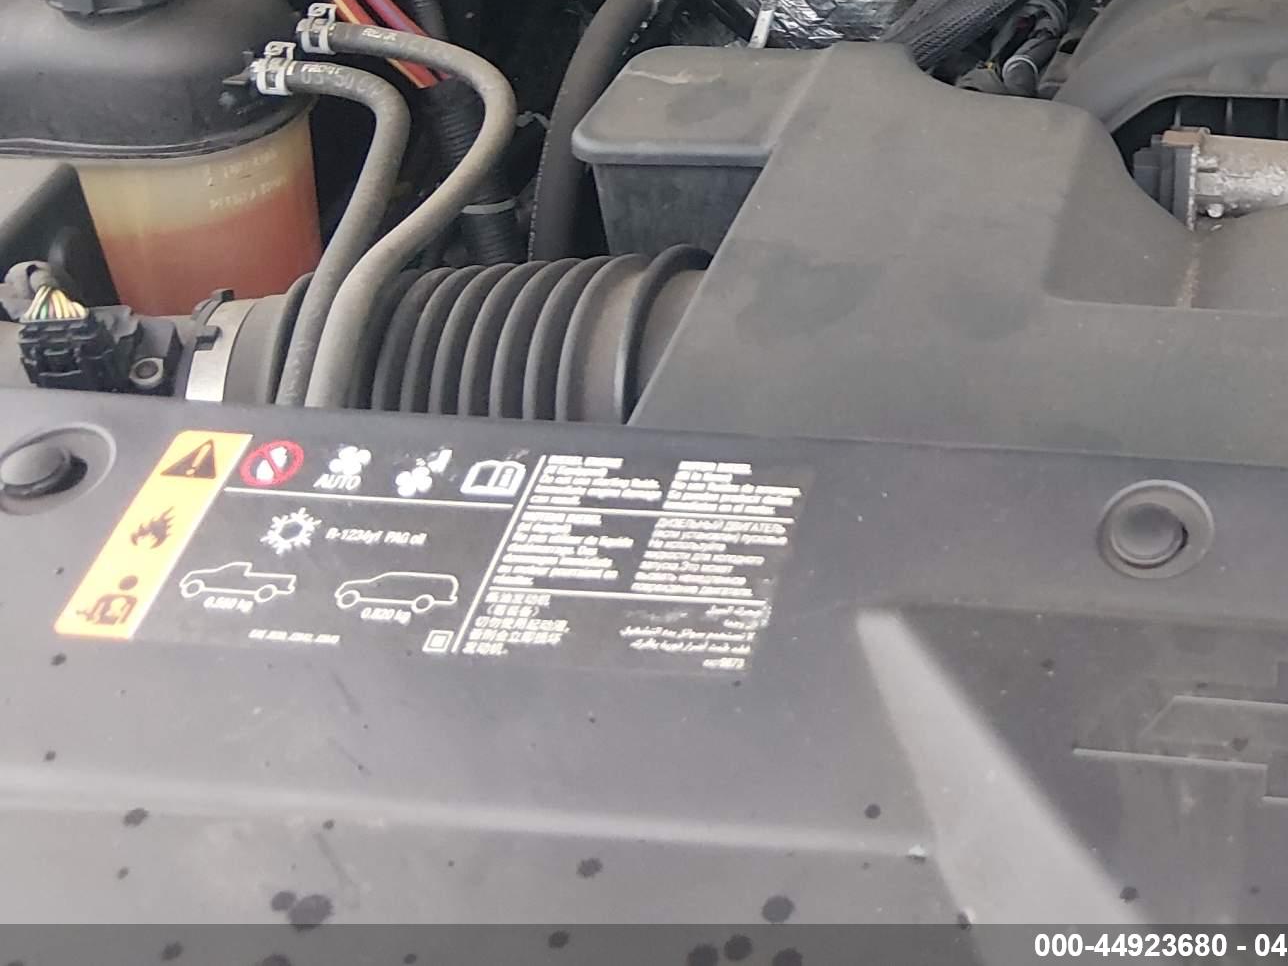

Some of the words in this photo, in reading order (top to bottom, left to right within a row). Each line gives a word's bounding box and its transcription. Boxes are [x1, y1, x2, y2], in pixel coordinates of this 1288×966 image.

[313, 473, 361, 490] AUTO
[384, 531, 409, 545] PAG
[409, 532, 427, 545] oil
